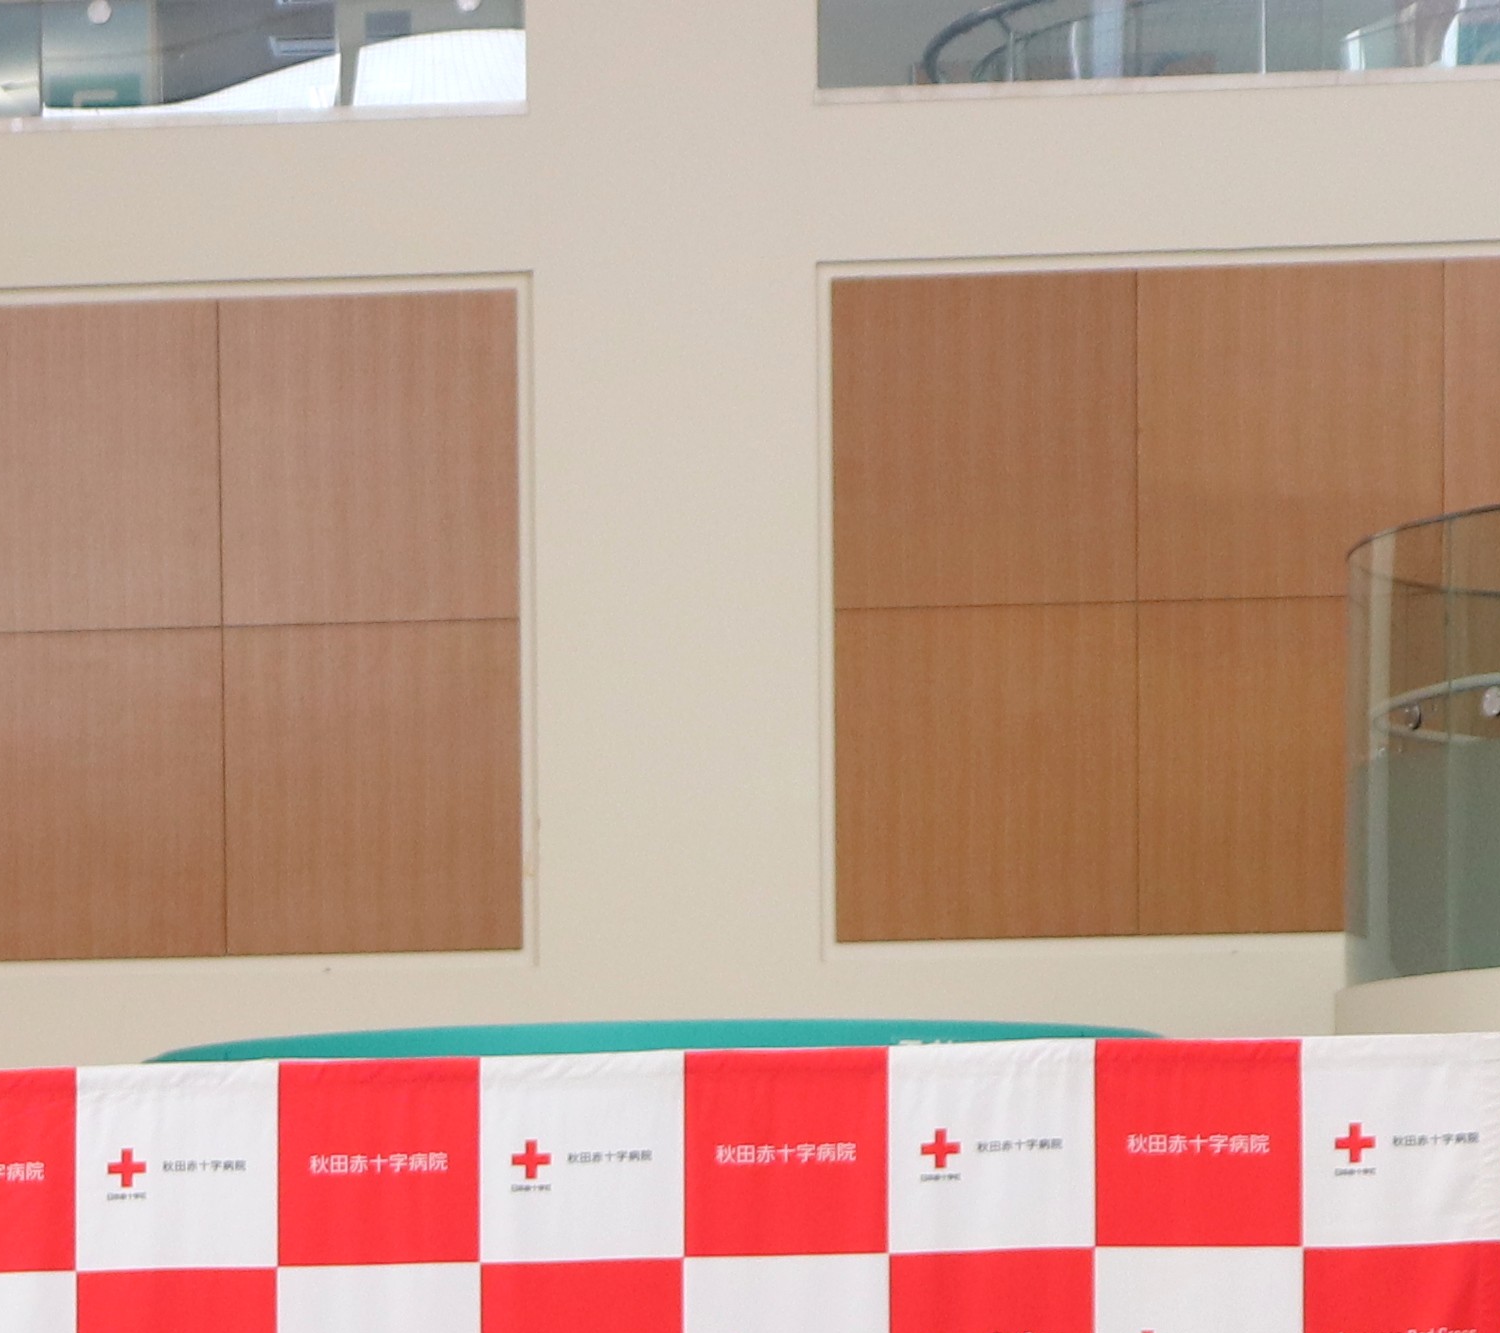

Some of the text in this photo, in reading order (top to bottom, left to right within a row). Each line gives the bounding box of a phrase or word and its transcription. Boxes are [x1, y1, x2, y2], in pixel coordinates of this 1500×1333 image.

[977, 1137, 1063, 1154] 秋田赤十字病院
[1127, 1133, 1270, 1155] 秋田赤十字病院
[1392, 1131, 1480, 1148] 秋田赤十字病院
[567, 1149, 653, 1164] 秋田赤十字病院
[715, 1142, 857, 1165] 秋田赤十字病院
[162, 1159, 247, 1172] 秋田赤十字病院
[309, 1151, 449, 1175] 秋田赤十字病院
